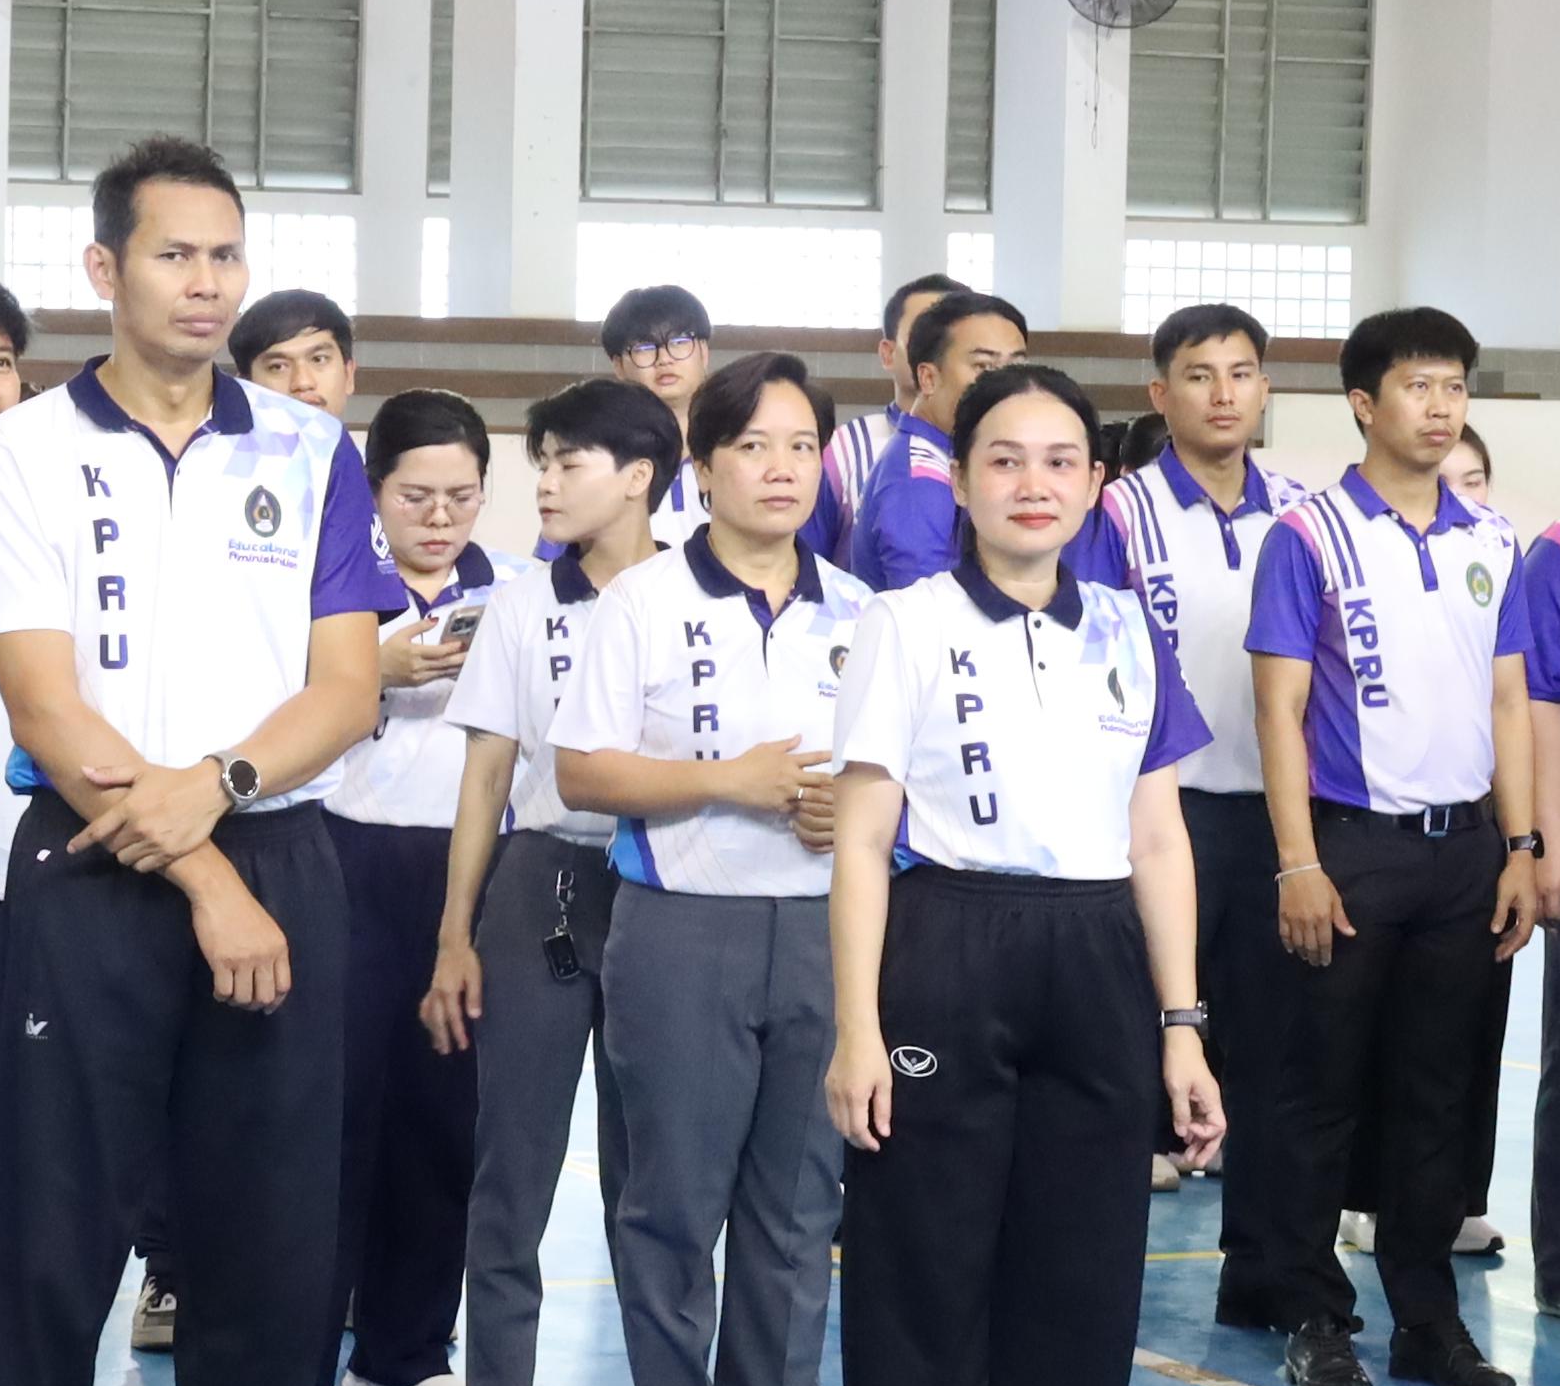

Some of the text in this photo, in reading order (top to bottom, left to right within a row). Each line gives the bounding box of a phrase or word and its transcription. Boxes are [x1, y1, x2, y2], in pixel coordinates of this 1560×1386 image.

[81, 464, 128, 669] KPRU
[1344, 598, 1389, 708] KPRU
[950, 647, 998, 826] KPRU
